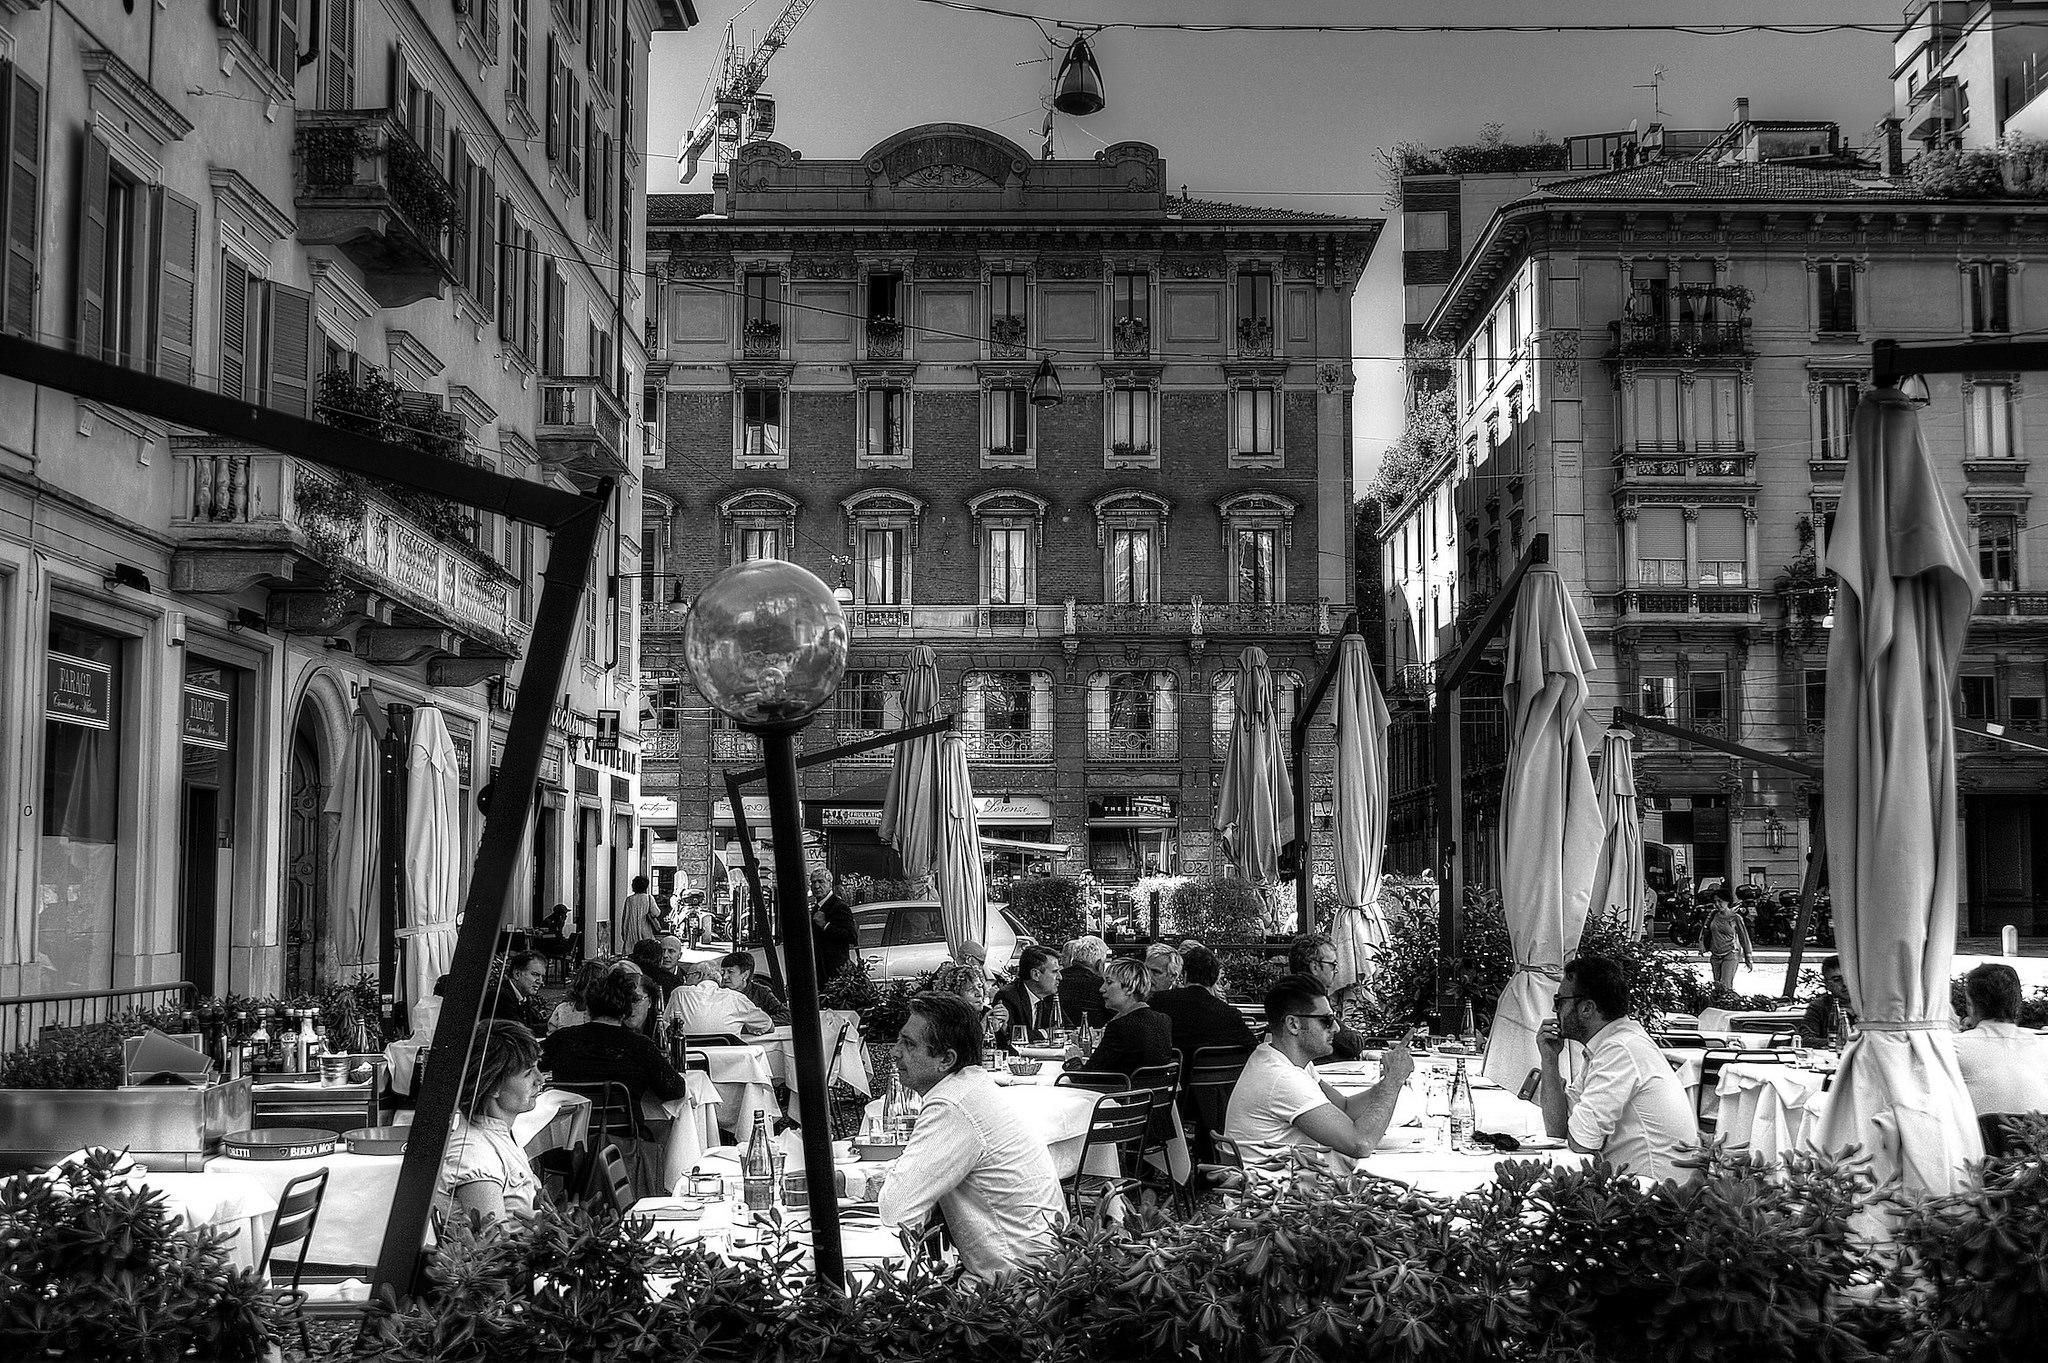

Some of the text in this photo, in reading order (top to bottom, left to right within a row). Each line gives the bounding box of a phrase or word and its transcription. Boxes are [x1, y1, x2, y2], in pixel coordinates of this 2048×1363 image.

[60, 667, 92, 697] FARAGE
[190, 697, 215, 722] FARAGE
[983, 799, 1029, 813] Lorenzi
[290, 1146, 318, 1157] BIRRA
